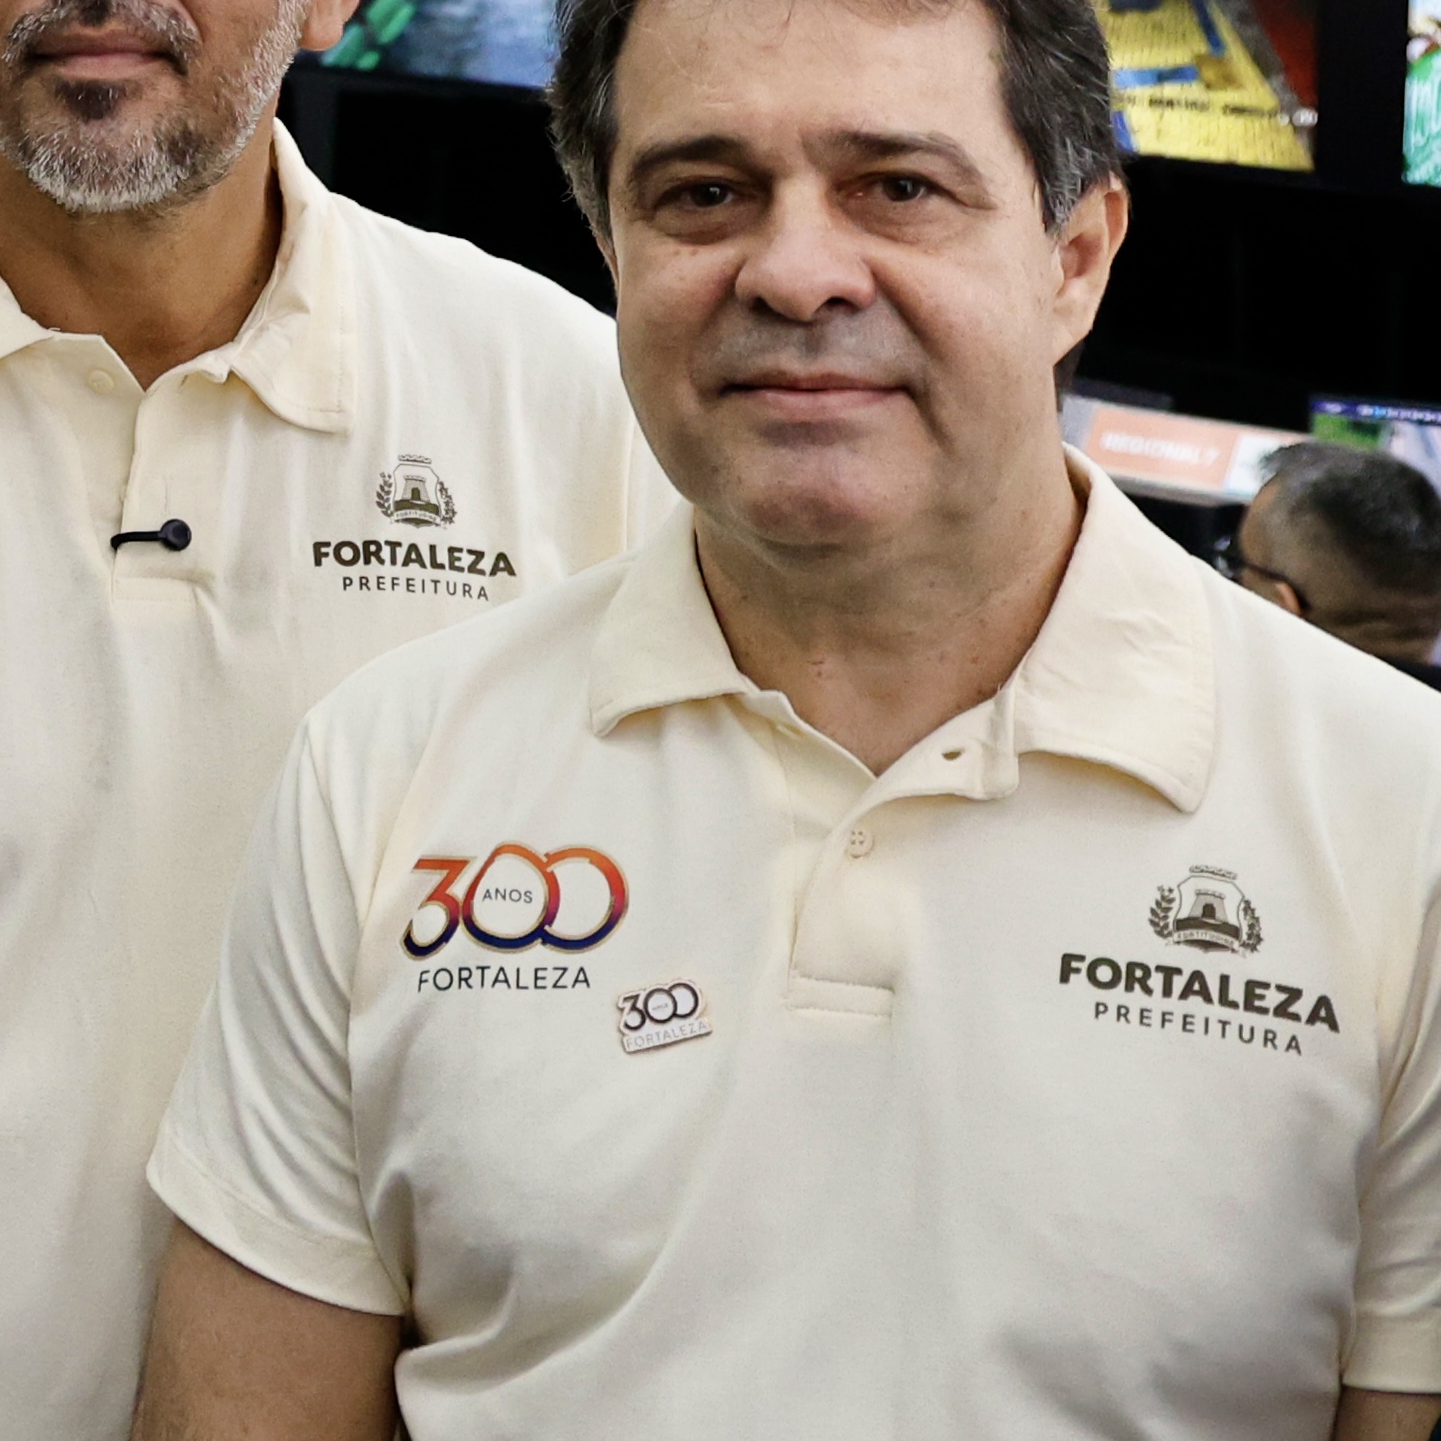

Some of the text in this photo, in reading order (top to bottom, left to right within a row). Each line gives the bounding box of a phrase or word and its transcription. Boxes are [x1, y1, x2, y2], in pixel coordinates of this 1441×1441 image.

[312, 539, 517, 578] FORTALEZA
[342, 576, 489, 602] PREFEITURA
[400, 840, 630, 961] 300
[482, 887, 533, 904] ANOS
[417, 965, 592, 993] FORTALEZA
[1059, 952, 1341, 1034] FORTALEZA
[622, 982, 699, 1031] 300
[626, 1020, 708, 1049] FORTALEZA
[1094, 1000, 1303, 1056] PREFEITURA
